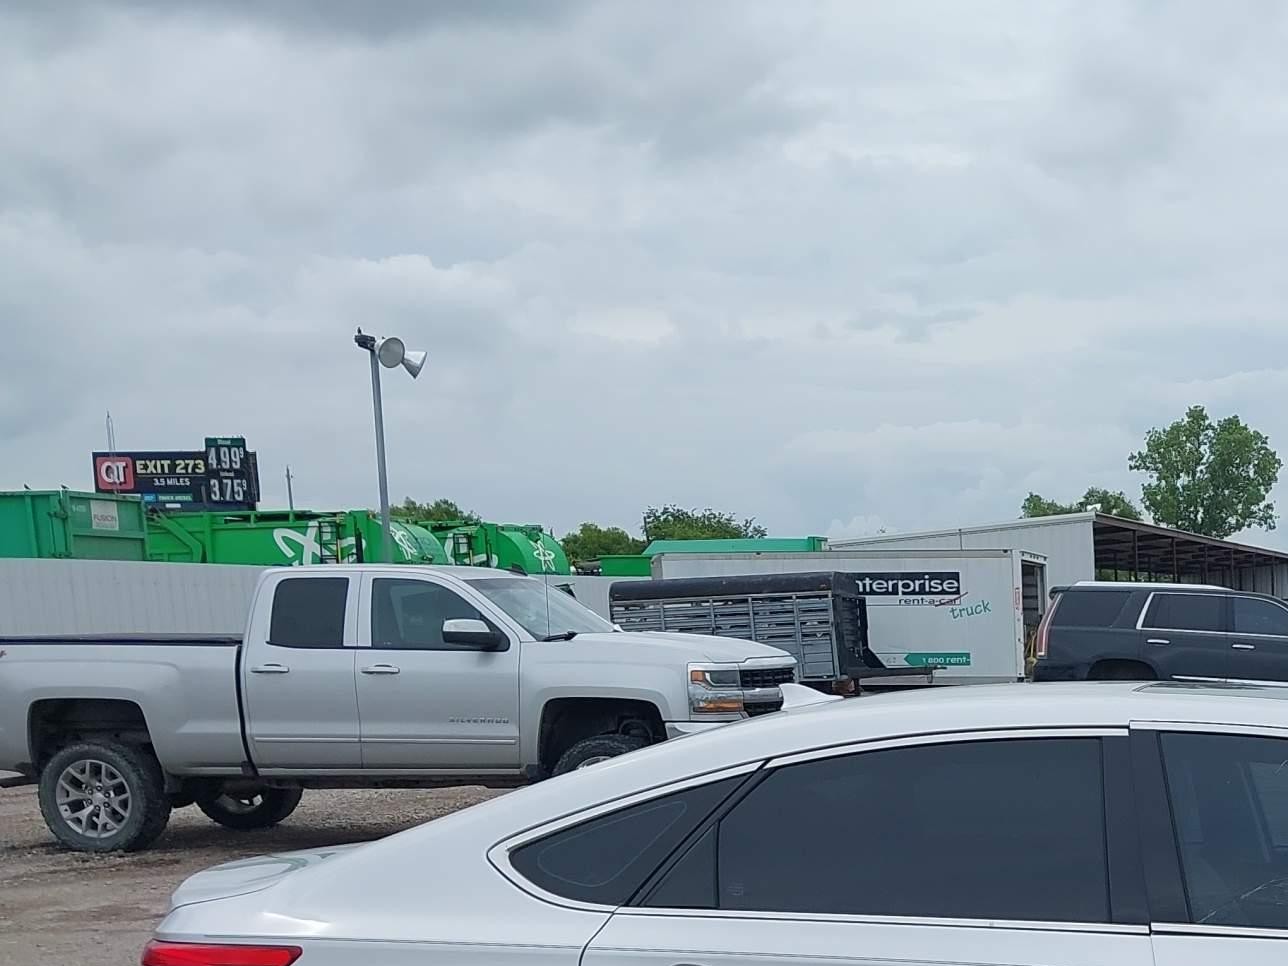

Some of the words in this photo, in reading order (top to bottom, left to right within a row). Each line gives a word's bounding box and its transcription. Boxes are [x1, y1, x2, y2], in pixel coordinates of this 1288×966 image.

[100, 461, 127, 483] QT
[136, 460, 171, 474] EXIT
[175, 460, 205, 474] 273
[153, 478, 165, 486] 3.5
[166, 478, 191, 486] MILES
[855, 575, 959, 596] nterprise
[949, 600, 992, 620] truck
